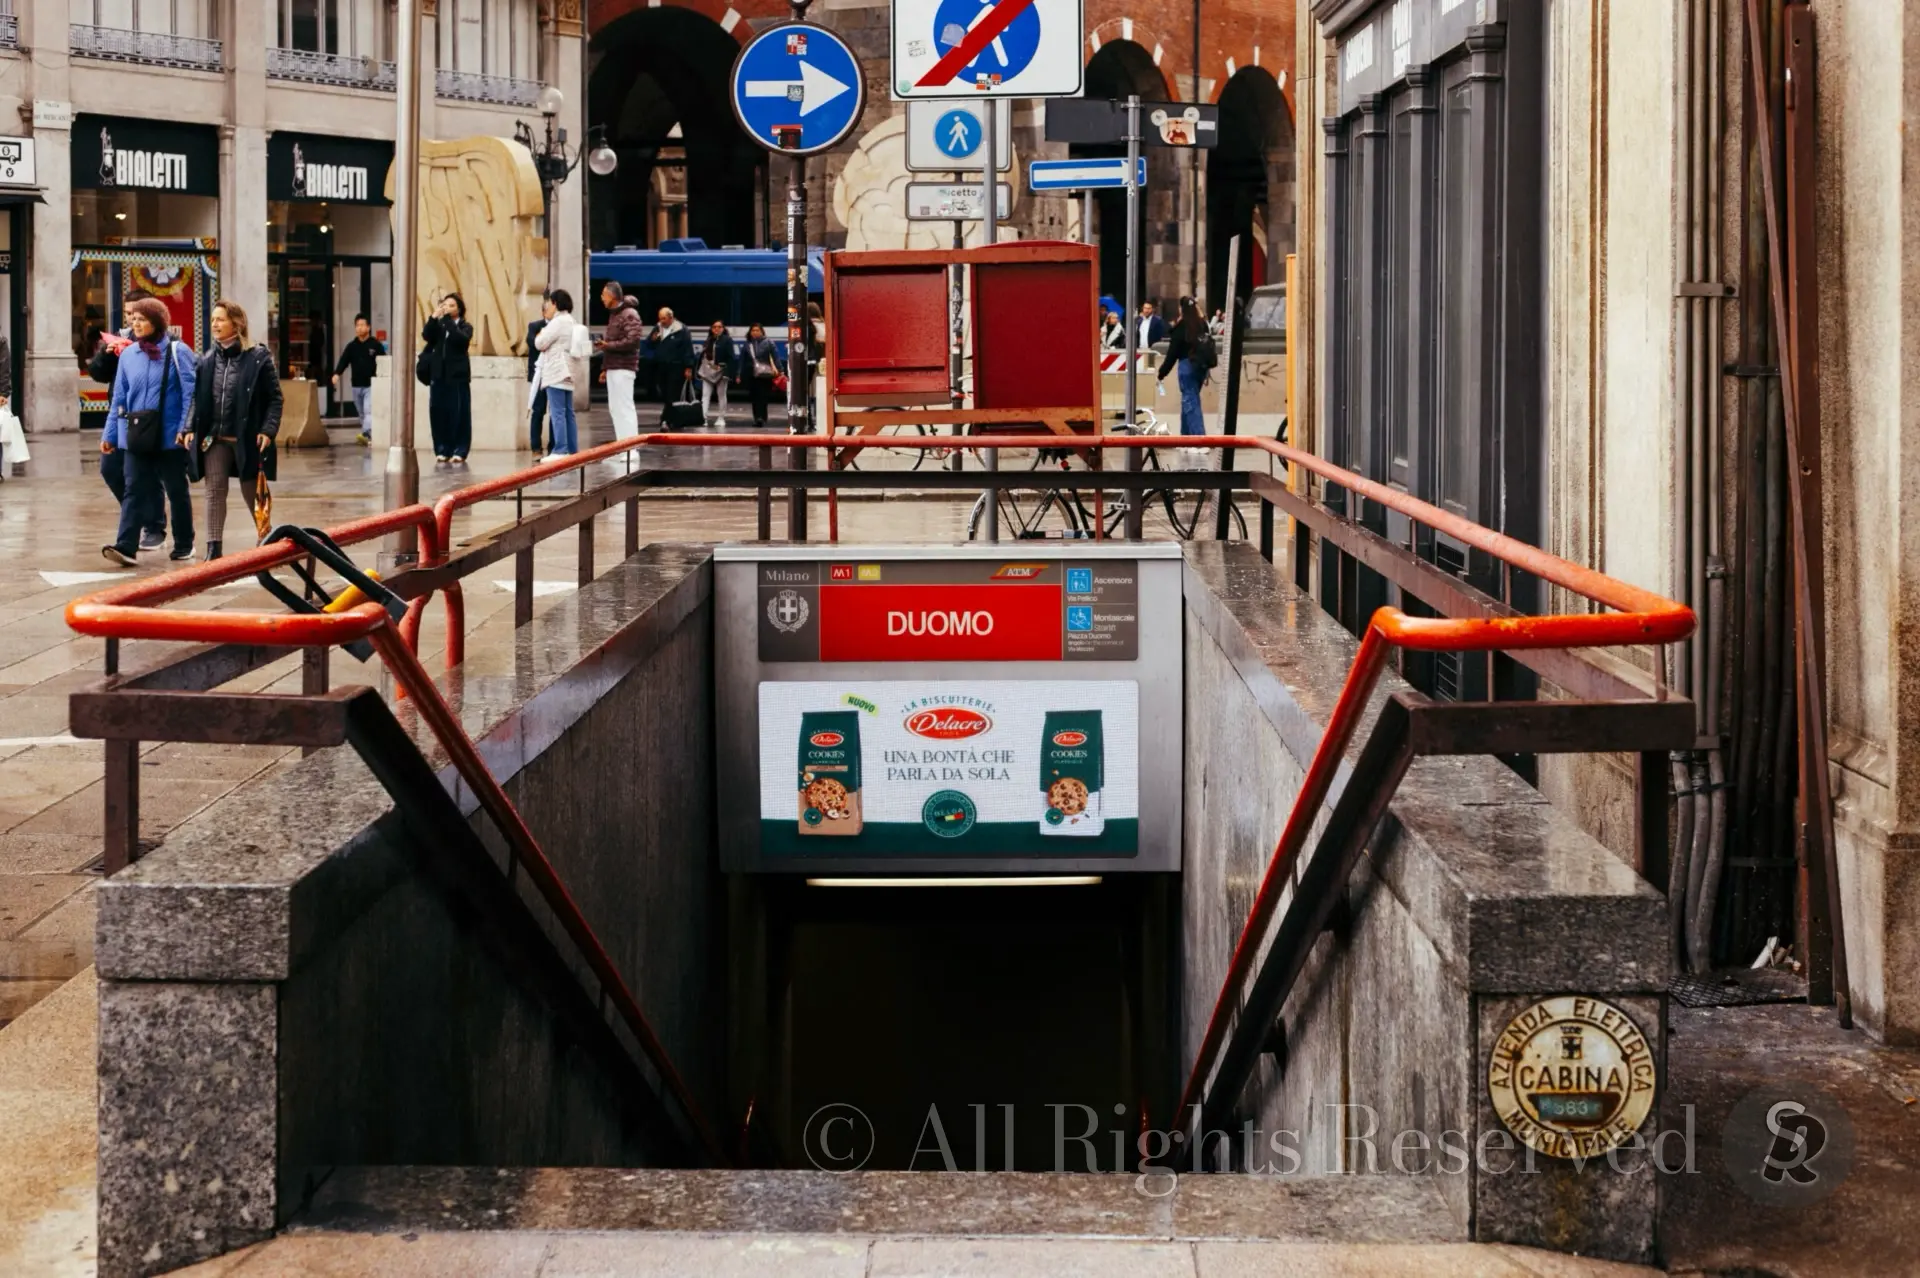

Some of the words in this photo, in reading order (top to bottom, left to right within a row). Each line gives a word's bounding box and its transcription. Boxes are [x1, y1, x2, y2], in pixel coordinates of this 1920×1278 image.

[115, 149, 187, 189] BIALETTI
[306, 163, 368, 200] BIALETTI
[766, 570, 810, 581] Milano
[833, 568, 850, 578] M1
[1007, 567, 1031, 576] ATM
[887, 610, 994, 636] DUOMO
[1093, 614, 1135, 622] Montascale
[847, 696, 876, 713] NUOVO
[913, 712, 983, 732] Delacre
[808, 750, 845, 759] COOKIES
[884, 750, 918, 764] UNA
[923, 746, 978, 764] BONTÀ
[981, 750, 1016, 764] CHE
[1050, 750, 1088, 759] COOKIES
[887, 767, 938, 781] PARLA
[942, 767, 964, 781] DA
[968, 767, 1011, 781] SOLA
[1491, 1005, 1554, 1089] AZIENDA
[1573, 998, 1653, 1093] ELETTRICA
[1520, 1066, 1624, 1092] CABINA
